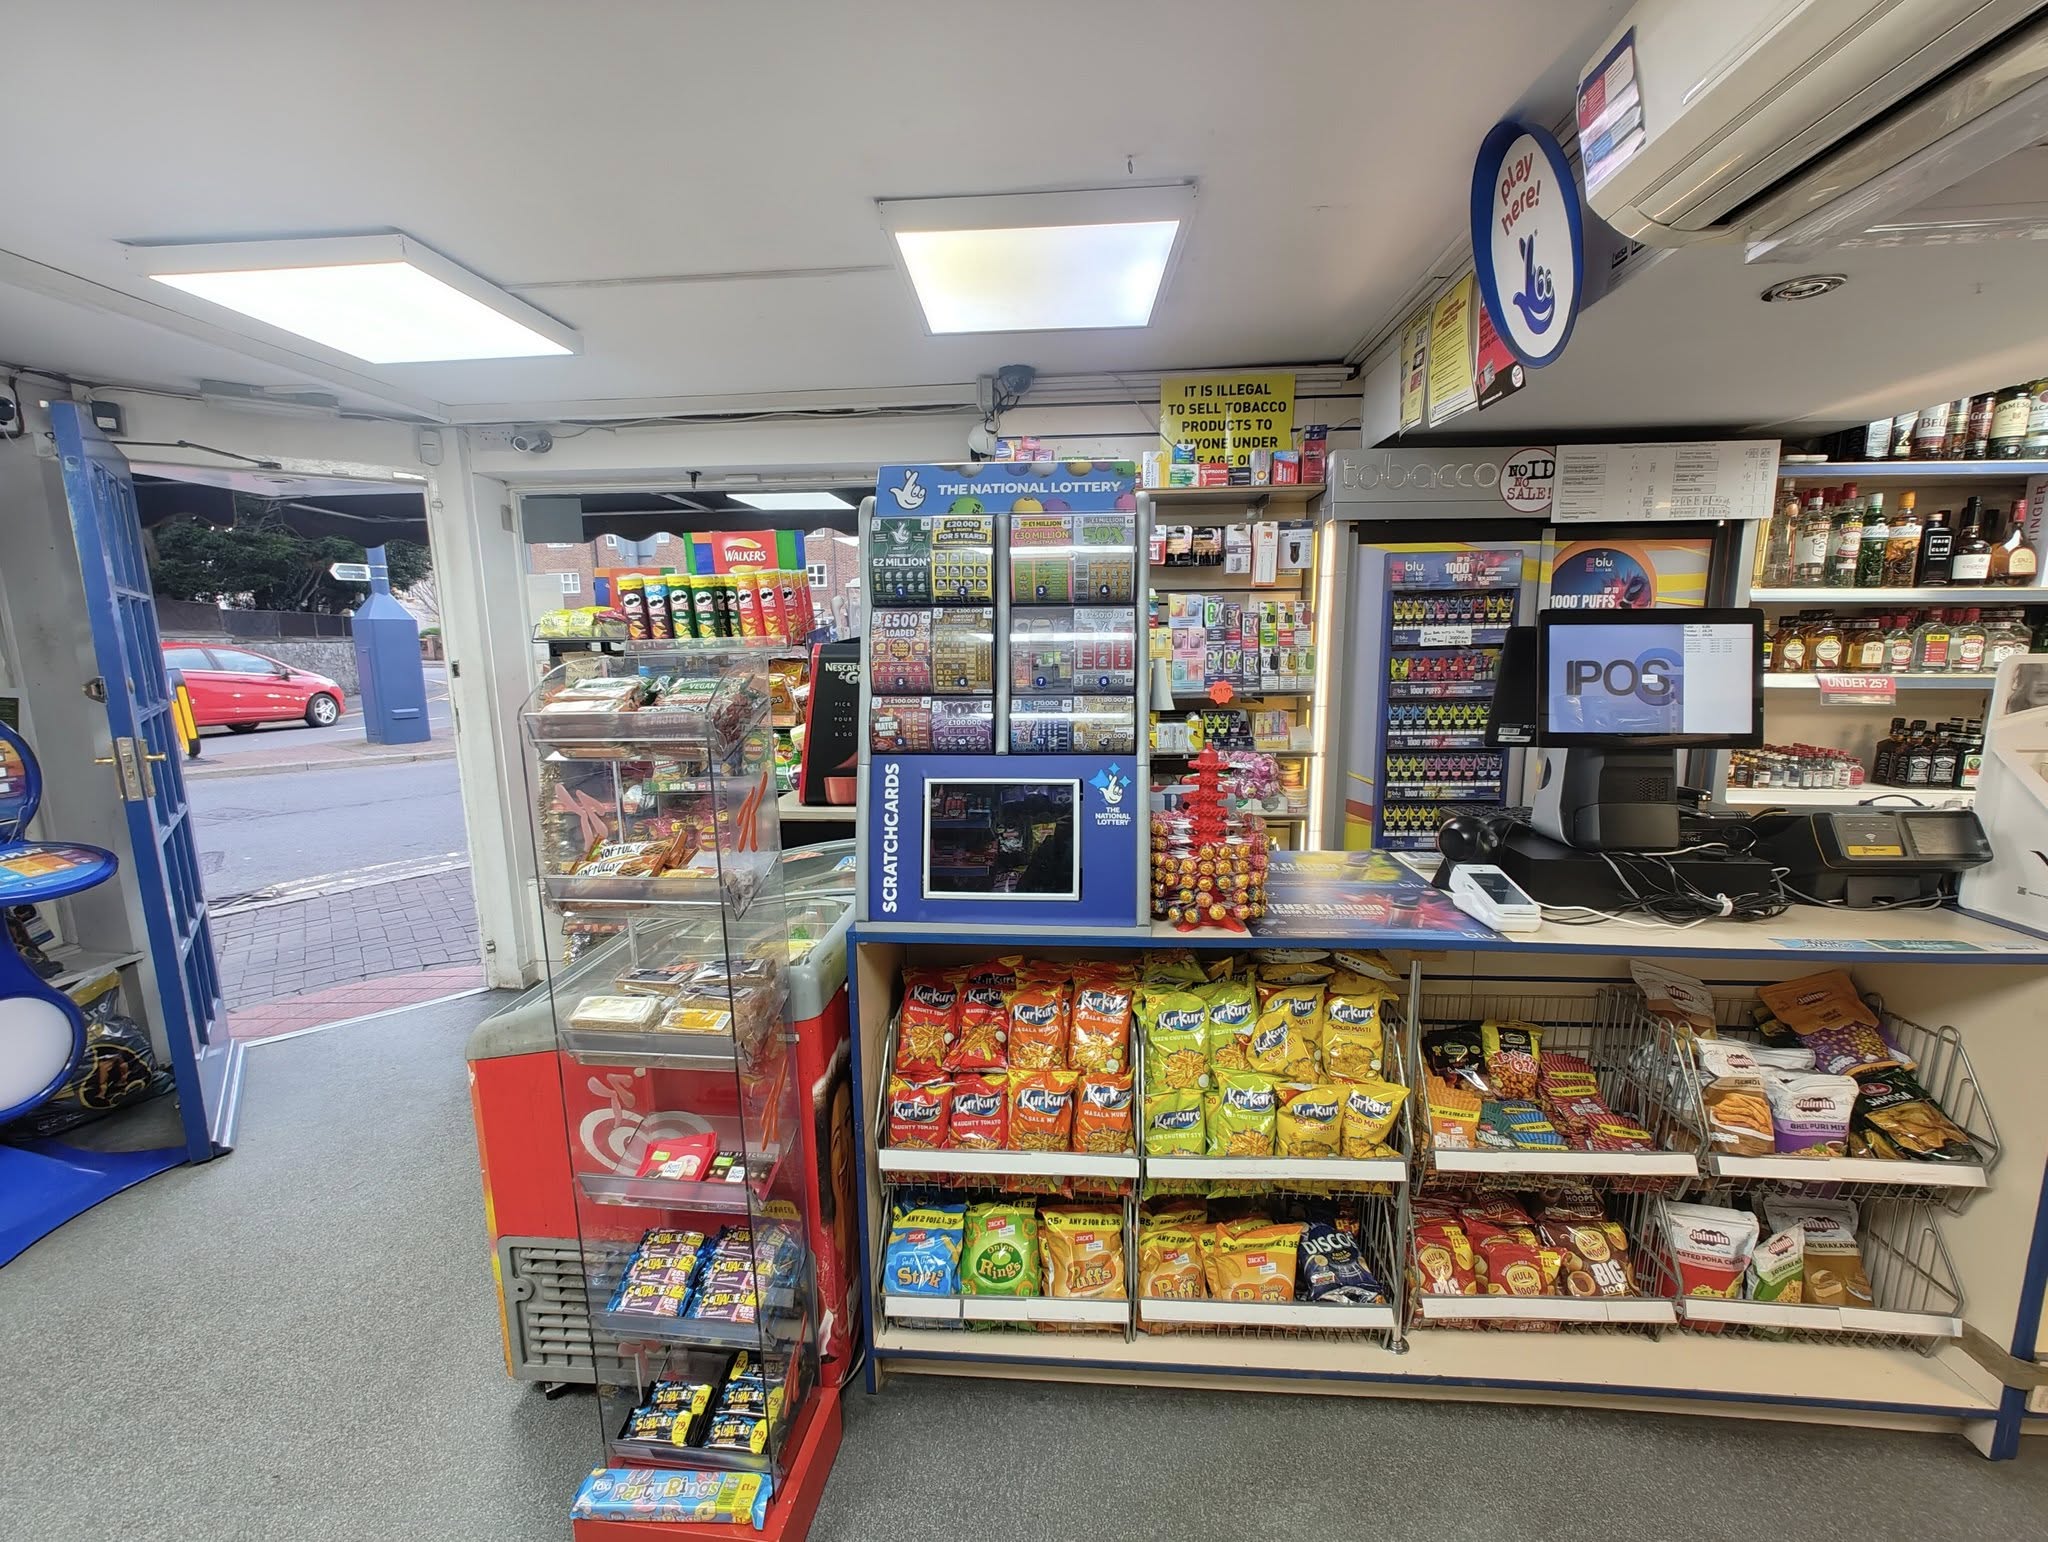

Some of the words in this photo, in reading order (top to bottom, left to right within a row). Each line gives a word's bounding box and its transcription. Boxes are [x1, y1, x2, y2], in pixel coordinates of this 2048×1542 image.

[1501, 152, 1534, 206] play
[1184, 386, 1197, 397] IT
[1200, 385, 1213, 397] IS
[1217, 383, 1272, 397] ILLEGAL
[1168, 404, 1185, 416] TO
[1189, 403, 1221, 414] SELL
[1225, 401, 1287, 414] TOBACCO
[1181, 420, 1252, 432] PRODUCTS
[1255, 418, 1272, 430] TO
[1232, 437, 1279, 449] UNDER
[1209, 455, 1234, 467] AGE
[1343, 454, 1499, 491] tobacco
[1508, 465, 1527, 477] NO
[1527, 459, 1556, 479] ID
[938, 484, 967, 496] THE
[970, 482, 1049, 495] NATIONAL
[1051, 481, 1121, 493] LOTTERY
[1515, 477, 1529, 488] NO
[1507, 487, 1552, 501] SALE!
[1033, 532, 1069, 540] MILLION
[724, 550, 766, 562] WALKERS
[873, 558, 884, 566] £2
[885, 558, 927, 566] MILLION
[1595, 557, 1613, 568] blu
[1444, 562, 1470, 574] 1000
[1452, 573, 1473, 582] PUFFS
[1582, 594, 1616, 608] PUFFS
[885, 613, 918, 628] £500
[886, 629, 916, 637] LOADED
[838, 672, 845, 680] &
[1827, 678, 1867, 689] UNDER
[1869, 678, 1888, 689] 25?
[1095, 812, 1131, 821] NATIONAL
[882, 762, 900, 914] SCRATCHCARDS
[913, 984, 956, 1004] Kurkure
[1080, 990, 1128, 1011] Kurkure
[909, 1006, 933, 1014] NAUGHTY
[1014, 1002, 1059, 1023] Kurkure
[1330, 1004, 1375, 1023] Kurkure
[1158, 1009, 1205, 1031] Kurkure
[1331, 1024, 1350, 1032] SOLID
[1086, 1085, 1133, 1105] Kurkure
[1207, 1096, 1217, 1104] 20
[1866, 1091, 1914, 1107] SAMOSA
[893, 1101, 942, 1119] Kurkure
[954, 1094, 1002, 1114] Kurkure
[1347, 1091, 1392, 1116] Kurkure
[1799, 1098, 1835, 1111] Jaimin
[1084, 1110, 1109, 1118] MASALA
[1293, 1102, 1339, 1120] Kurkure
[1154, 1110, 1201, 1130] Kurkure
[1344, 1112, 1363, 1124] SOLID
[1363, 1119, 1384, 1130] MASTI
[1486, 1203, 1511, 1214] SALTED
[936, 1216, 958, 1224] £1.35
[987, 1219, 1005, 1228] JACK'S
[1101, 1218, 1121, 1226] £1.35
[908, 1233, 926, 1241] JACK'S
[1690, 1230, 1731, 1246] Jaimin
[1275, 1240, 1299, 1249] £1.35
[1587, 1244, 1608, 1258] HOOPS
[1768, 1236, 1795, 1255] Jaimin
[1425, 1252, 1445, 1264] HULA
[1701, 1255, 1723, 1264] POHA
[978, 1259, 1022, 1280] Rings
[1512, 1271, 1534, 1281] HULA
[1591, 1259, 1627, 1287] BIG
[1070, 1266, 1112, 1289] Puffs
[1514, 1284, 1540, 1296] HOOPS
[611, 1481, 666, 1503] Party
[664, 1476, 722, 1500] Rings
